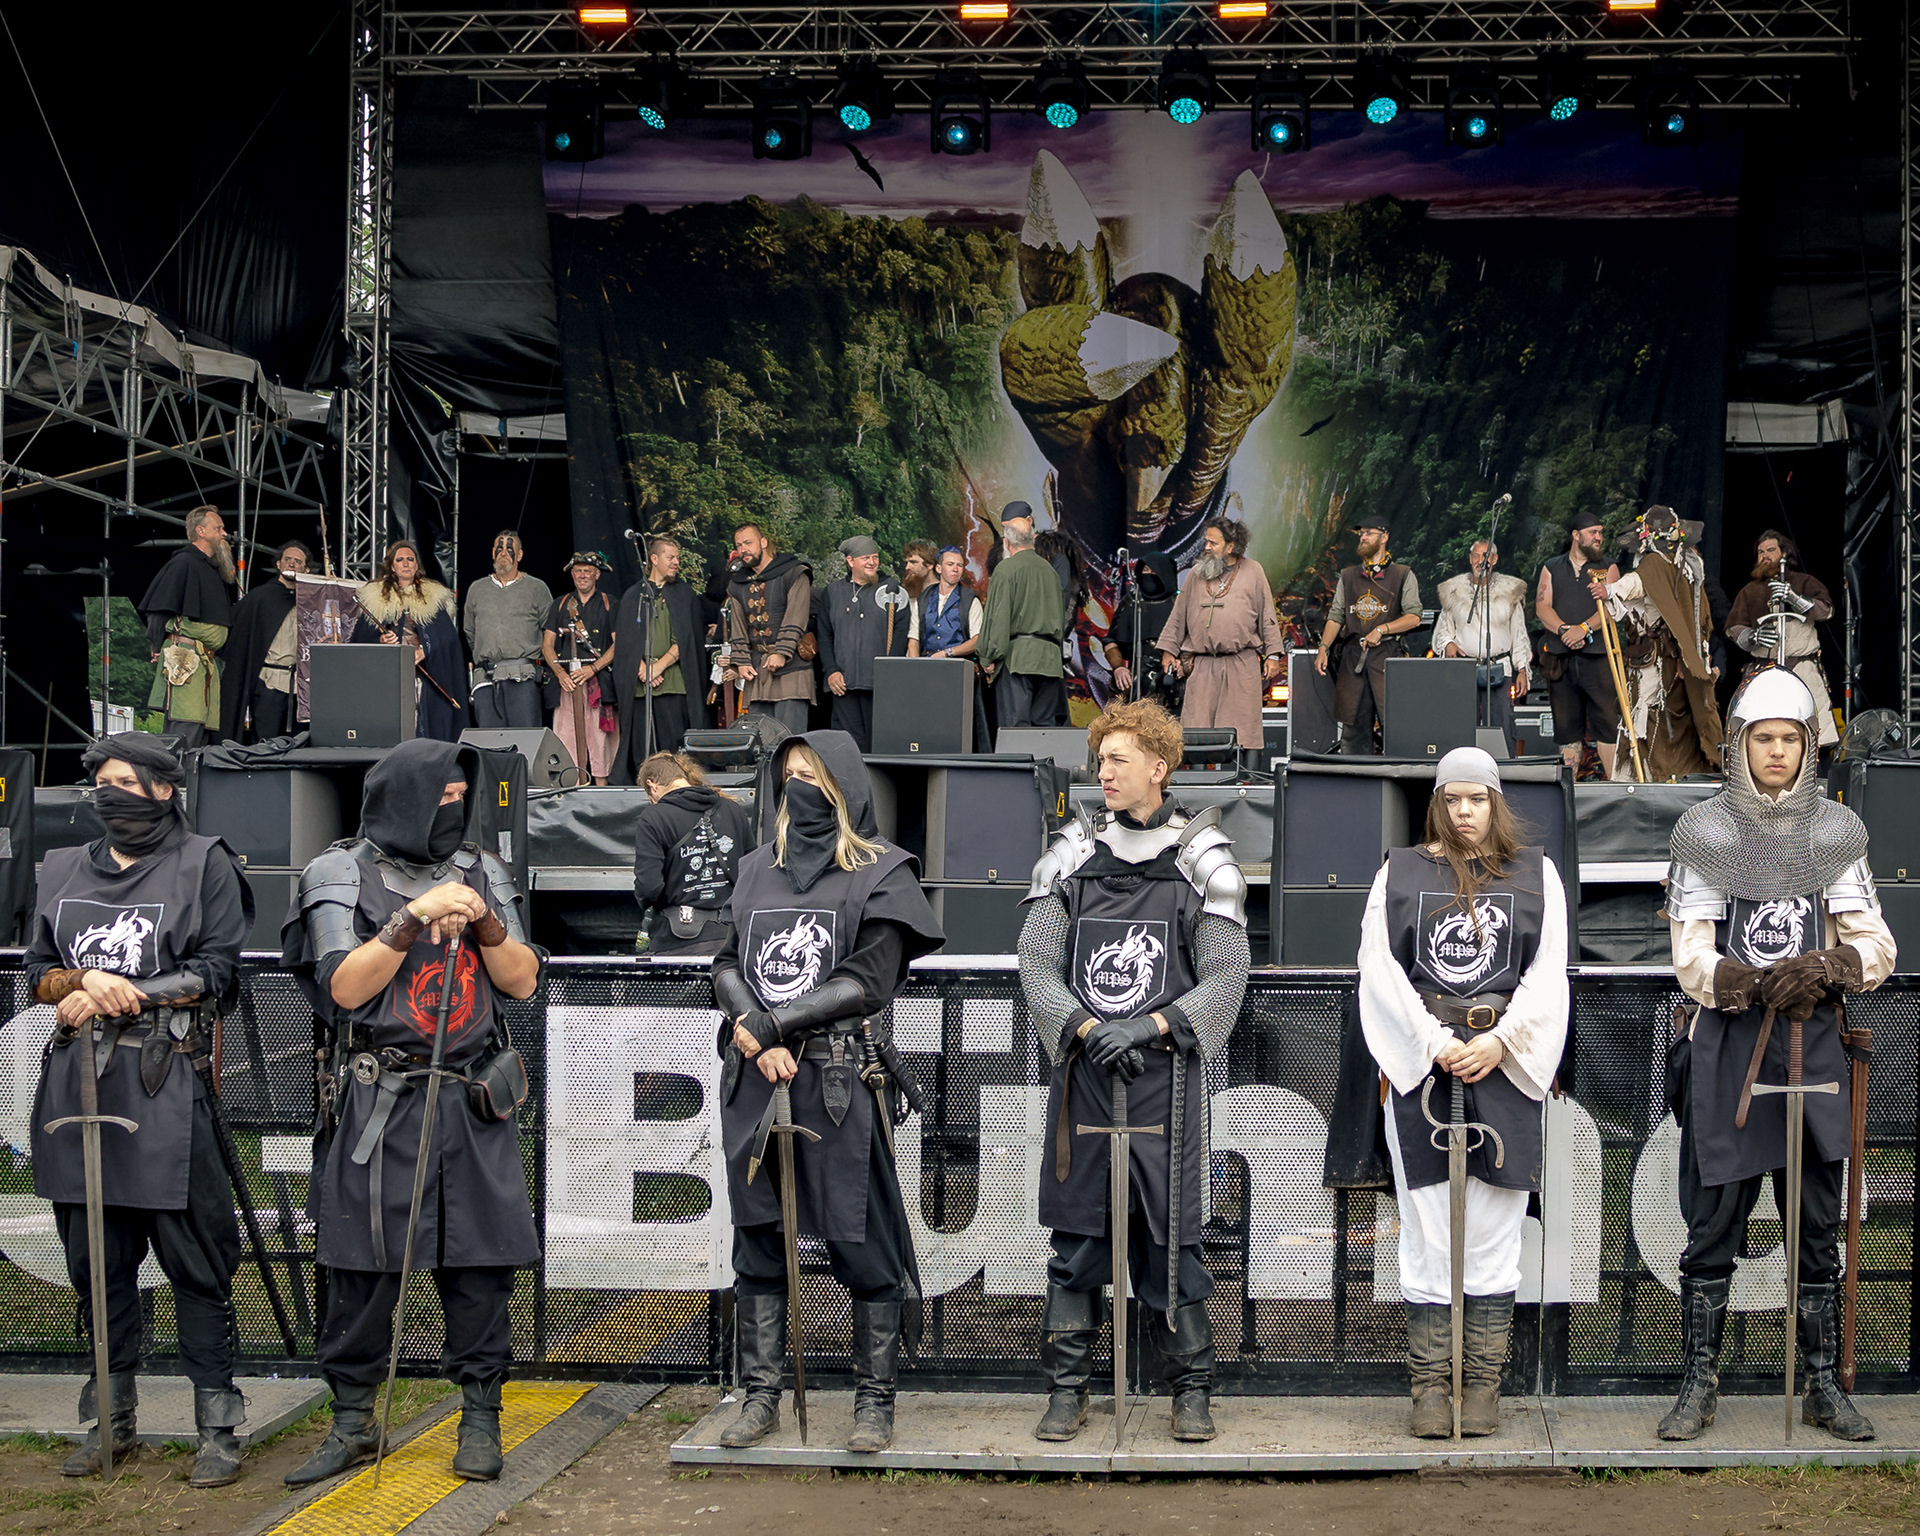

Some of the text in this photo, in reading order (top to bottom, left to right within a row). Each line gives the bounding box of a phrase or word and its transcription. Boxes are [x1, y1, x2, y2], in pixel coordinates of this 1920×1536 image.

[1751, 929, 1789, 946] MPS
[1438, 941, 1478, 960] MPS
[80, 954, 121, 970] MPS
[762, 959, 801, 977] MPS
[1093, 970, 1133, 988] MPS
